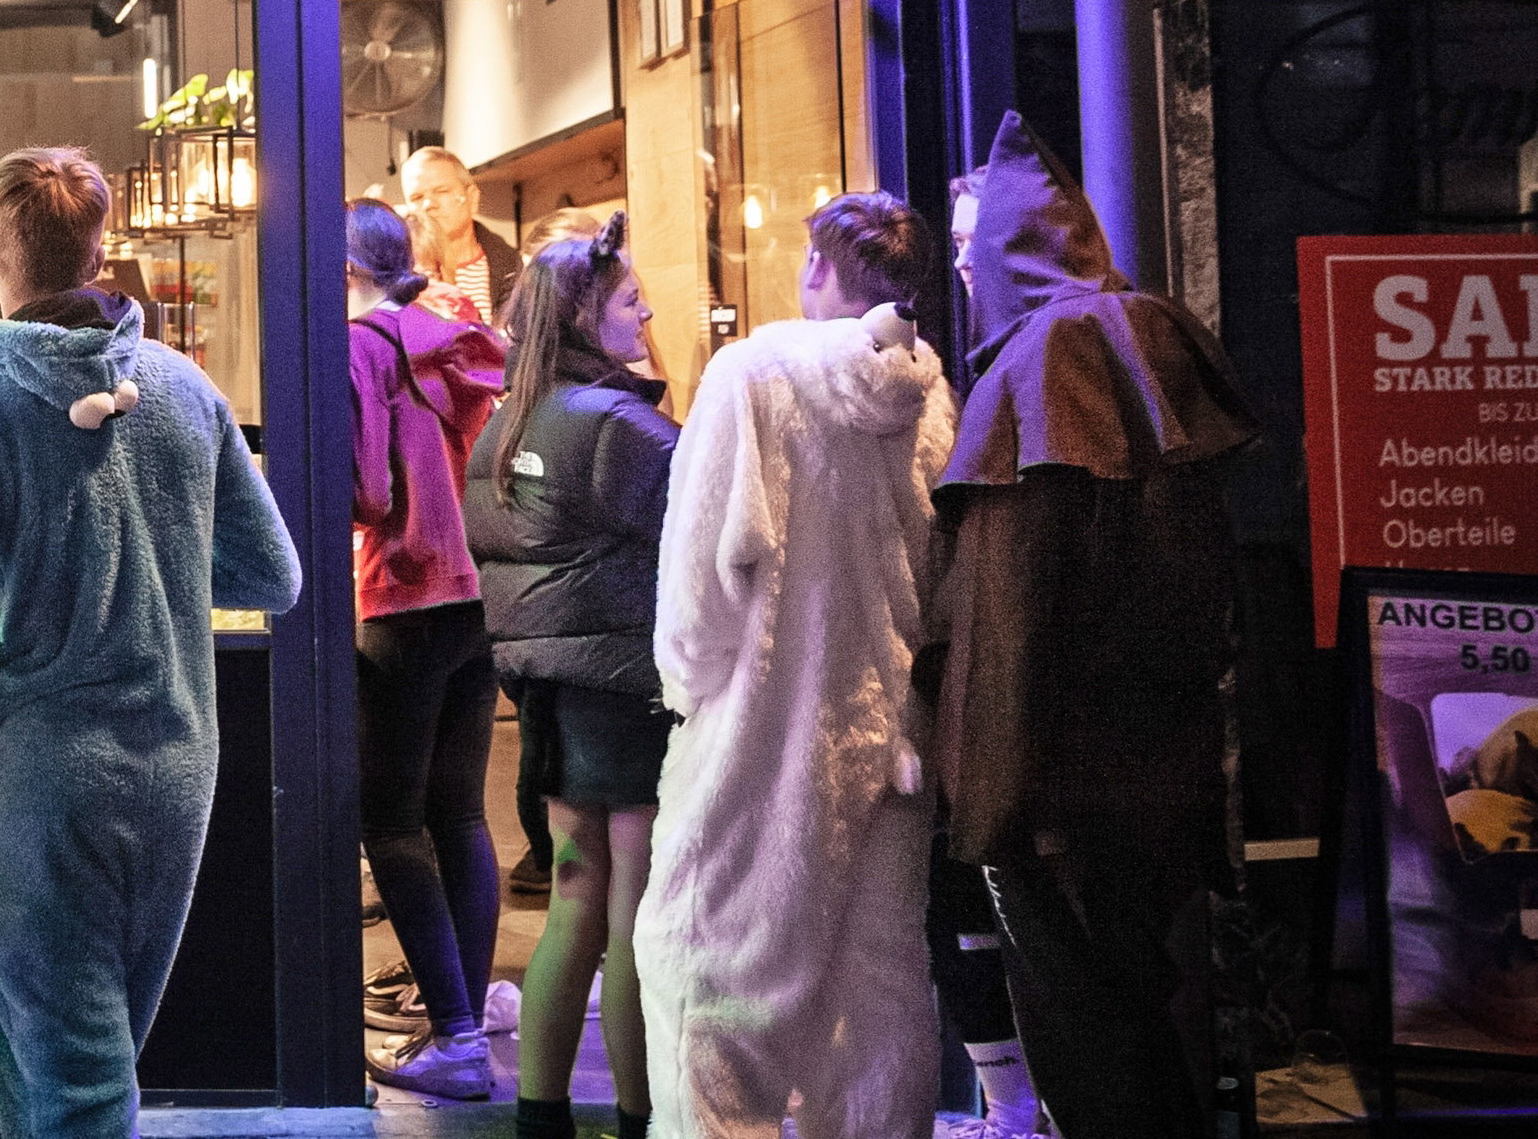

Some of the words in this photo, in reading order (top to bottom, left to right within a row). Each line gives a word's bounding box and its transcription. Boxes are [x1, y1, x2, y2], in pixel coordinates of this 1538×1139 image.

[1373, 365, 1475, 392] STARK
[1379, 477, 1486, 509] Jacken
[1382, 516, 1516, 549] Oberteile
[1378, 601, 1538, 633] ANGEBO
[1461, 643, 1531, 675] 5,50
